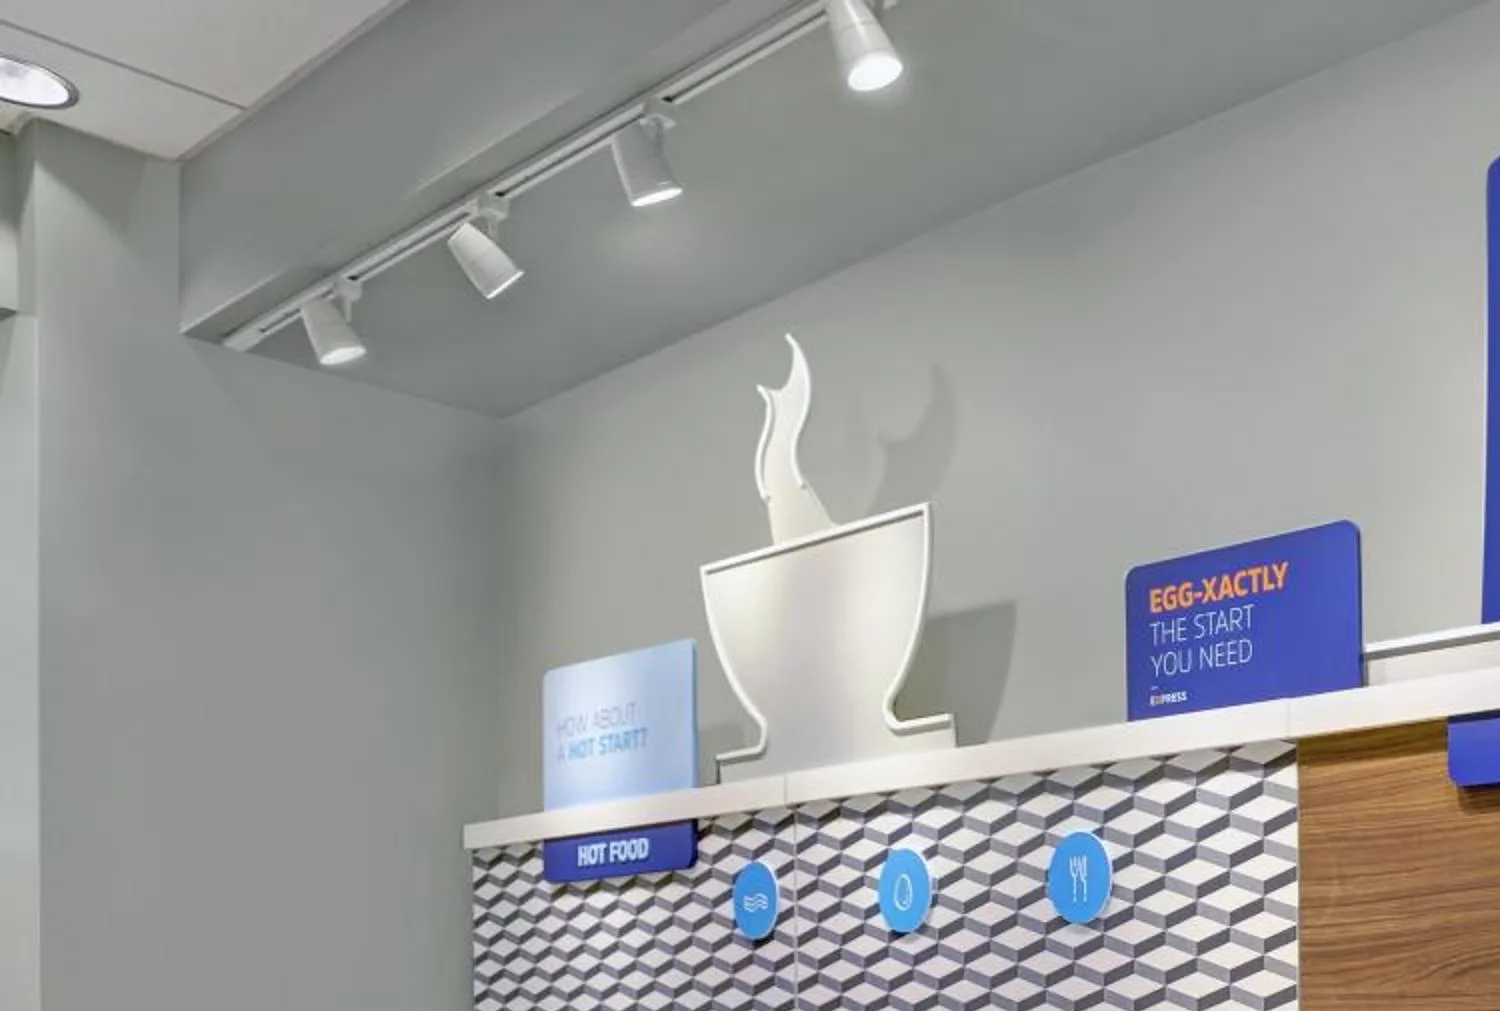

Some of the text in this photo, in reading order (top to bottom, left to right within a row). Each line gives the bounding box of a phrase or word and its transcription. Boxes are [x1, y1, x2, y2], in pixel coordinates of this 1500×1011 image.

[1149, 562, 1289, 613] EGG-XACTLY
[1149, 604, 1255, 646] THE START
[1150, 639, 1253, 678] YOU NEED
[592, 702, 638, 731] ABOUT
[568, 736, 596, 761] HOT
[576, 837, 650, 867] HOT FOOD
